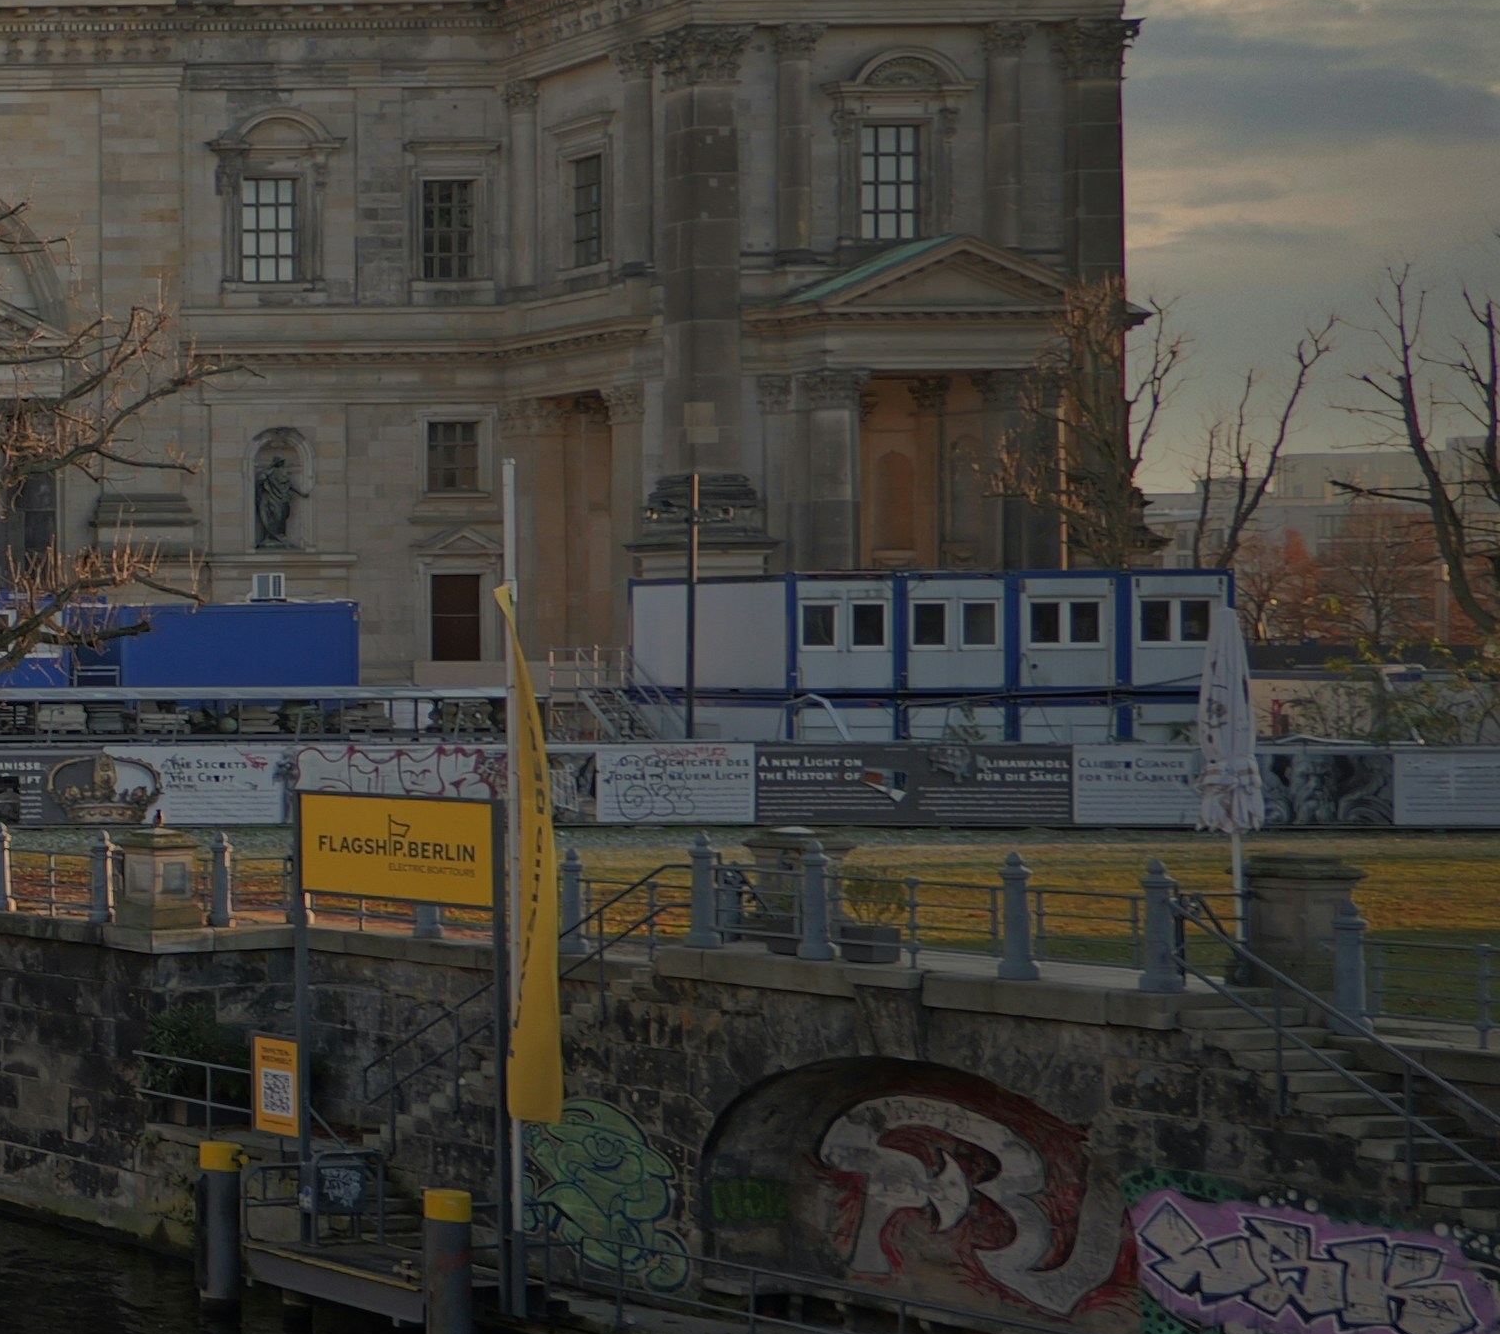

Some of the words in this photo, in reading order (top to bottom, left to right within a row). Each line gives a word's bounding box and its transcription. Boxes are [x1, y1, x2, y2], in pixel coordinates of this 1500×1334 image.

[726, 759, 750, 767] DES
[758, 756, 769, 767] A
[771, 758, 801, 767] NEW
[804, 756, 841, 767] LIGHT
[843, 758, 862, 767] ON
[987, 760, 1071, 769] LIMAWANDEL
[715, 770, 750, 781] LICHT
[758, 771, 782, 781] THE
[843, 771, 861, 781] OF
[1005, 773, 1027, 782] DIE
[1029, 770, 1070, 782] SÄRGE
[1107, 774, 1131, 782] THE
[319, 827, 476, 863] FLAGSHIP.BERLIN
